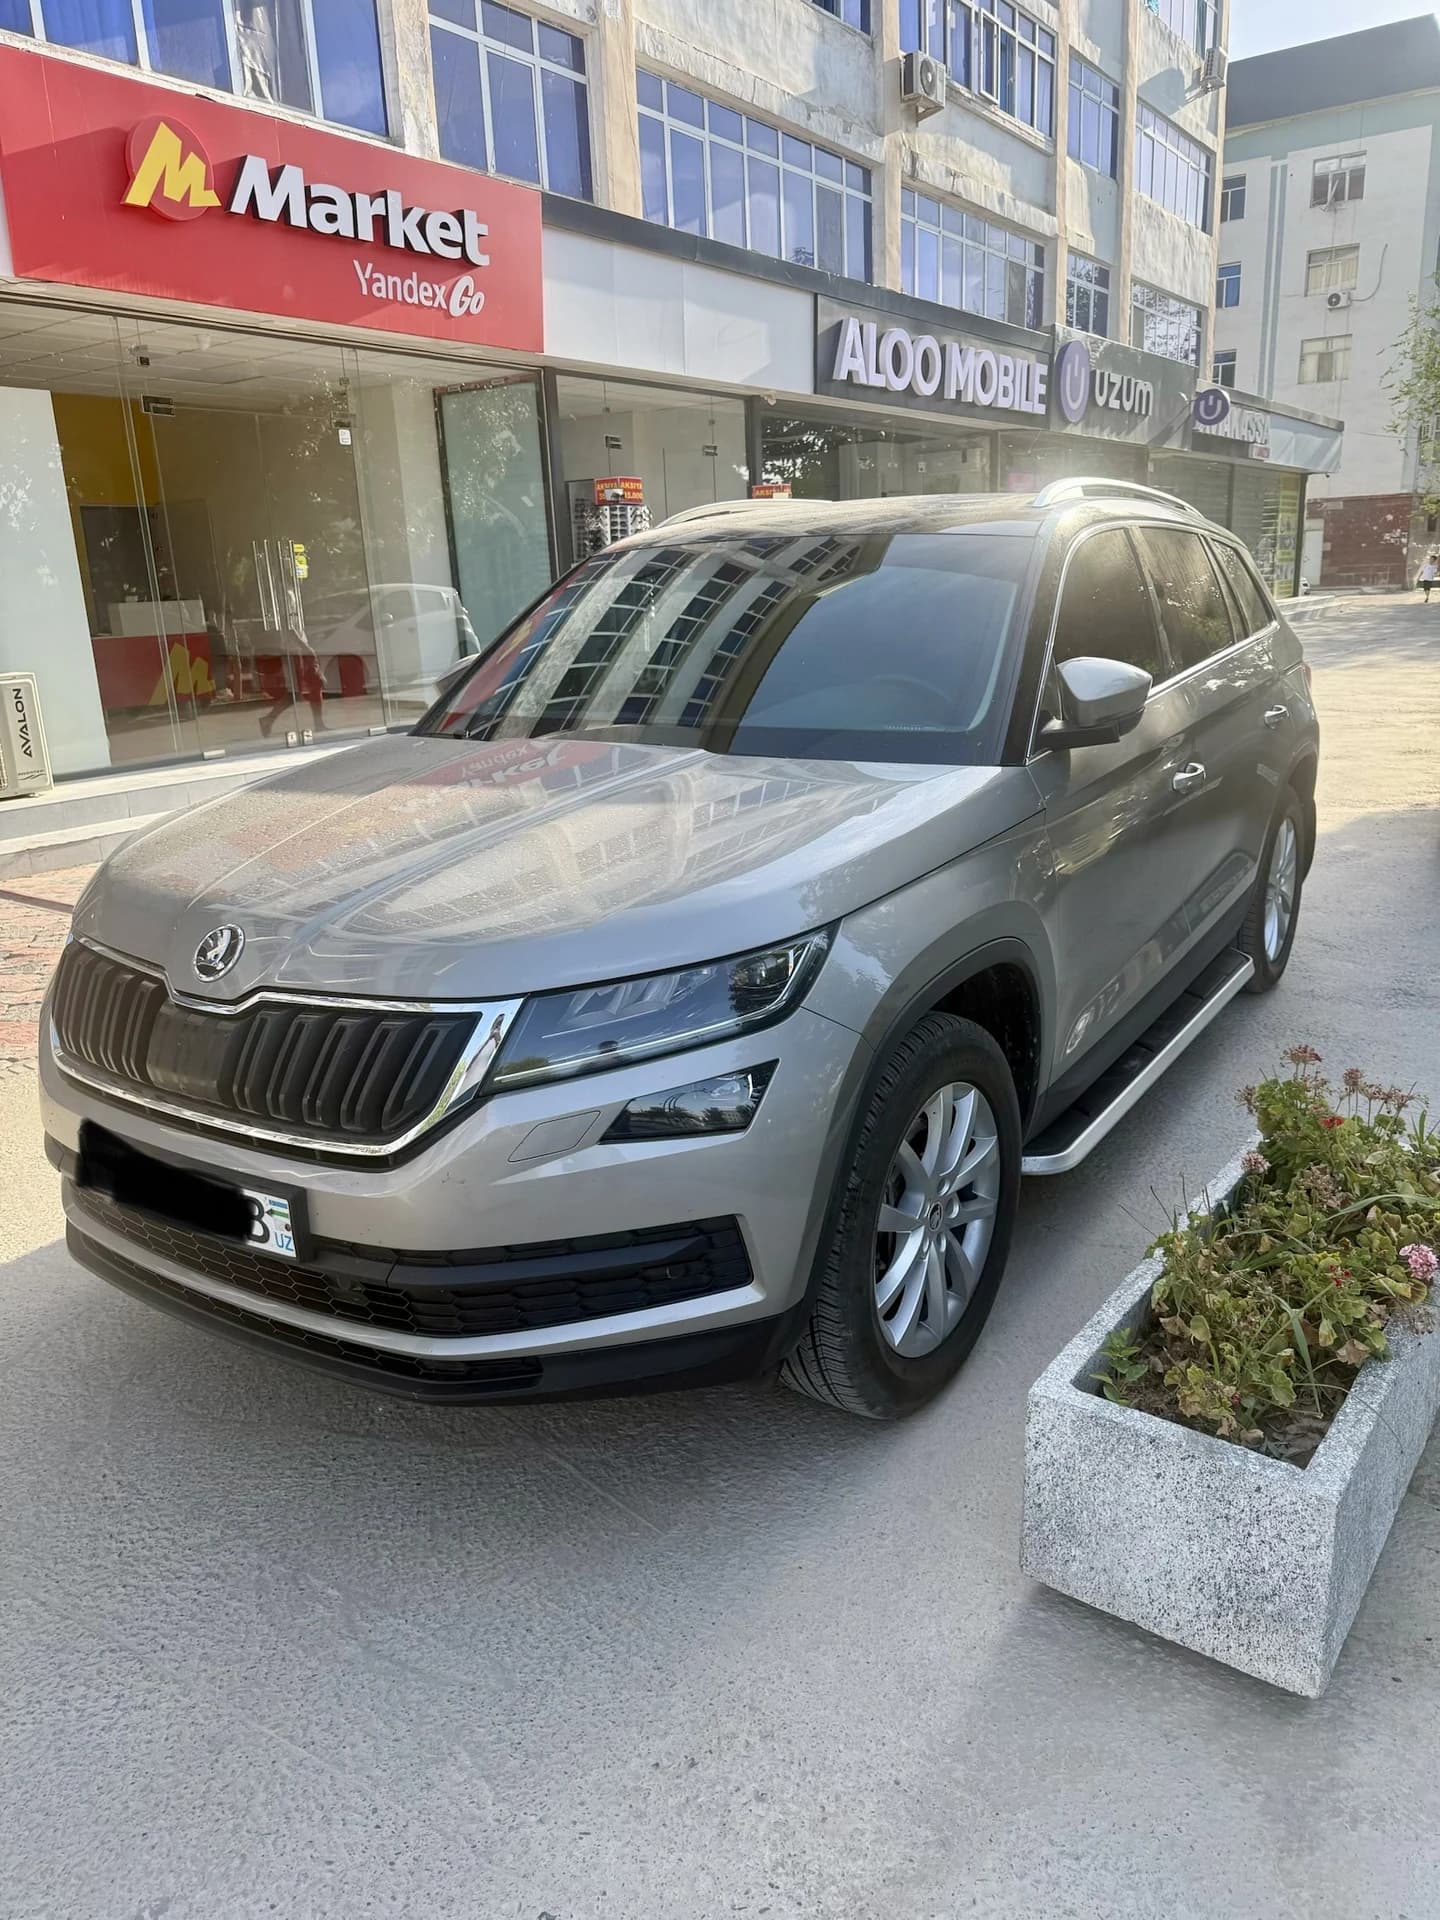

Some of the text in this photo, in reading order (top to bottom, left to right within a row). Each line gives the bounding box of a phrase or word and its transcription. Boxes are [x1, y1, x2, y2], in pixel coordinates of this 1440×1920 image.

[230, 155, 489, 267] Market
[353, 259, 485, 318] Yandex Go
[832, 317, 1048, 415] ALOO MOBILE
[12, 688, 33, 758] AVALON
[274, 1231, 294, 1251] UZ
